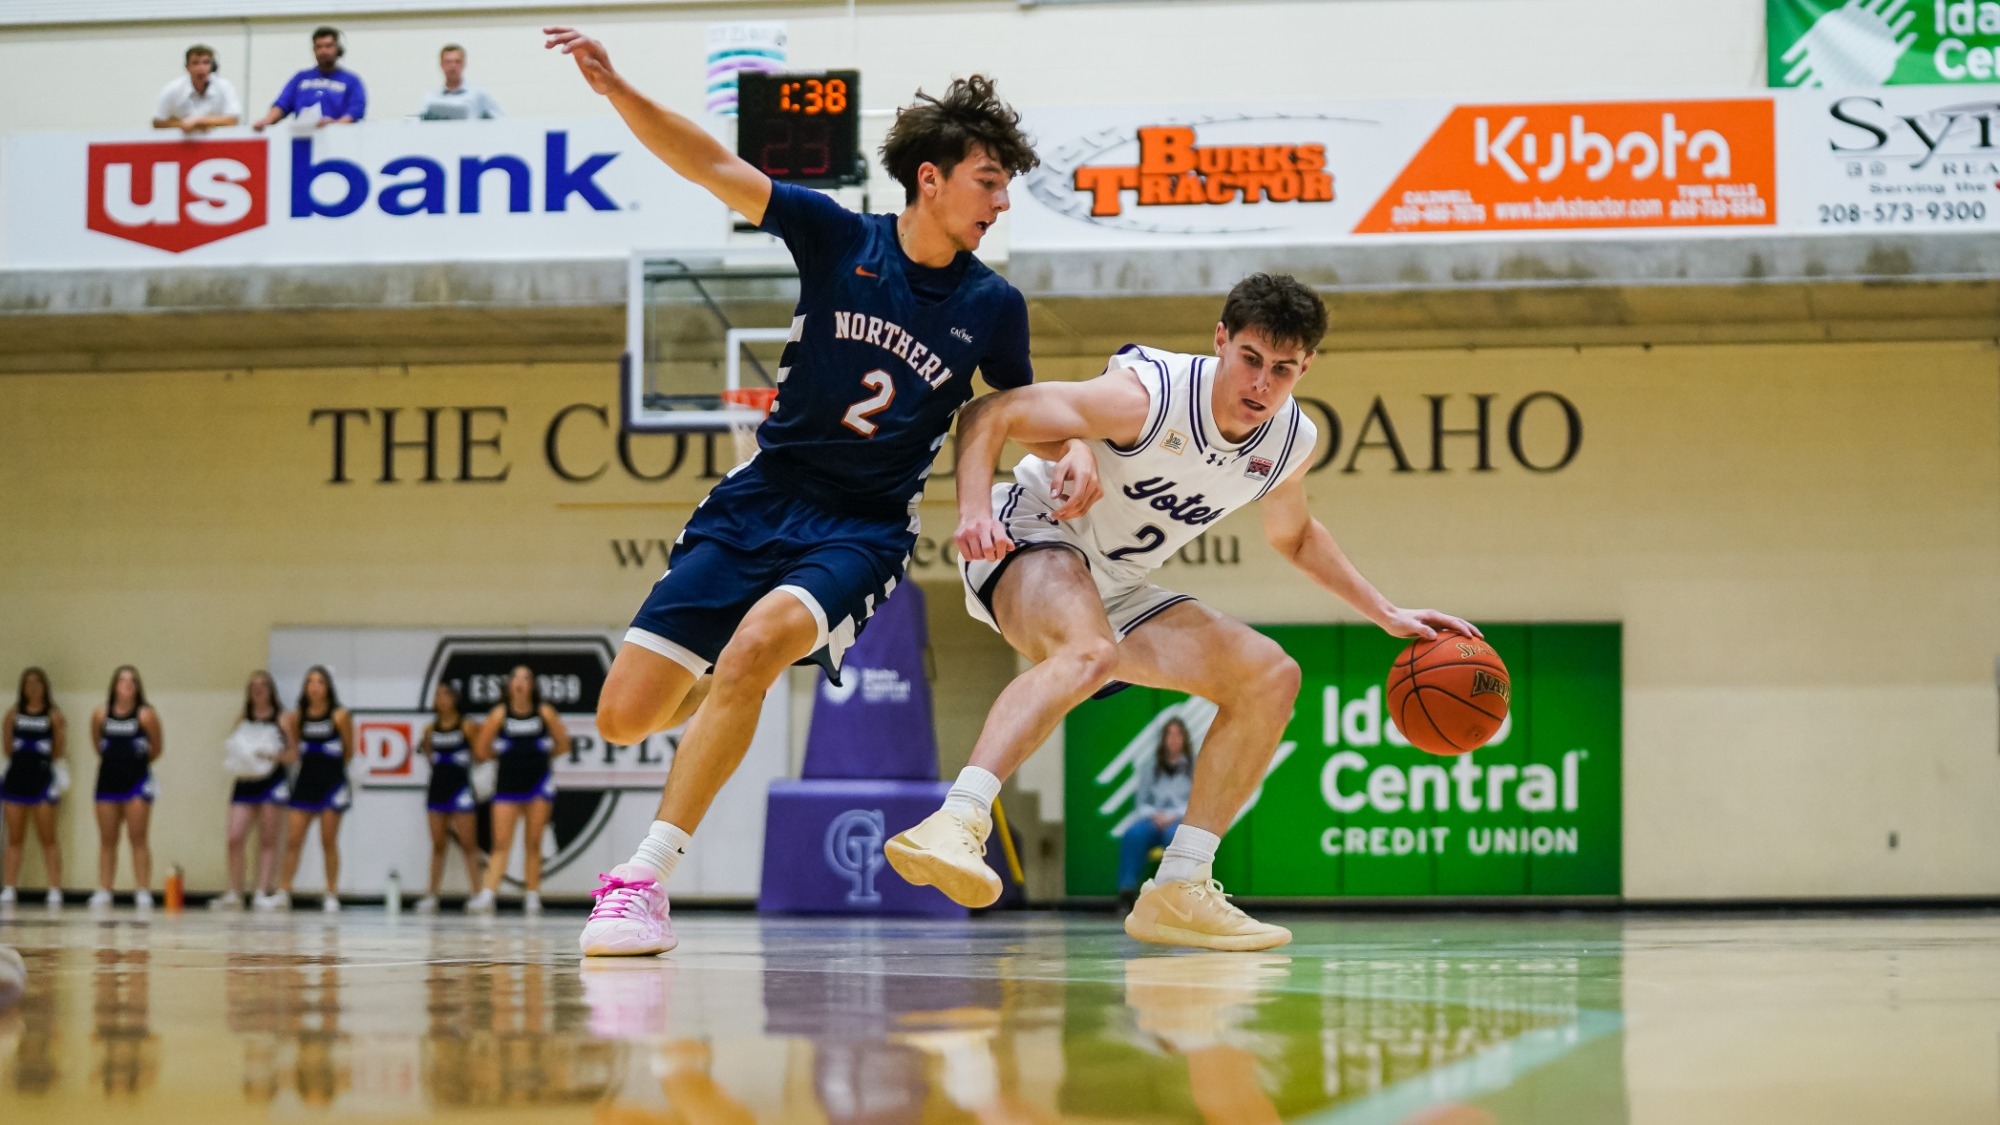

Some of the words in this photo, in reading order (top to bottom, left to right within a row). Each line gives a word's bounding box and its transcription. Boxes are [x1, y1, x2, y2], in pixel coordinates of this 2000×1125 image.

[779, 78, 848, 116] 1:38
[1136, 126, 1327, 175] BURKS
[1474, 113, 1732, 183] Kubota
[103, 157, 253, 226] us
[290, 130, 622, 218] bank
[1073, 164, 1335, 217] TRACTOR
[1818, 201, 1986, 223] 208-573-9300
[841, 368, 896, 439] 2
[309, 406, 512, 484] THE
[1300, 390, 1584, 477] DAHO
[1123, 477, 1226, 526] Yotes
[1105, 522, 1168, 563] 2
[1320, 750, 1579, 814] Central
[1320, 827, 1450, 856] CREDIT
[1467, 827, 1579, 856] UNION
